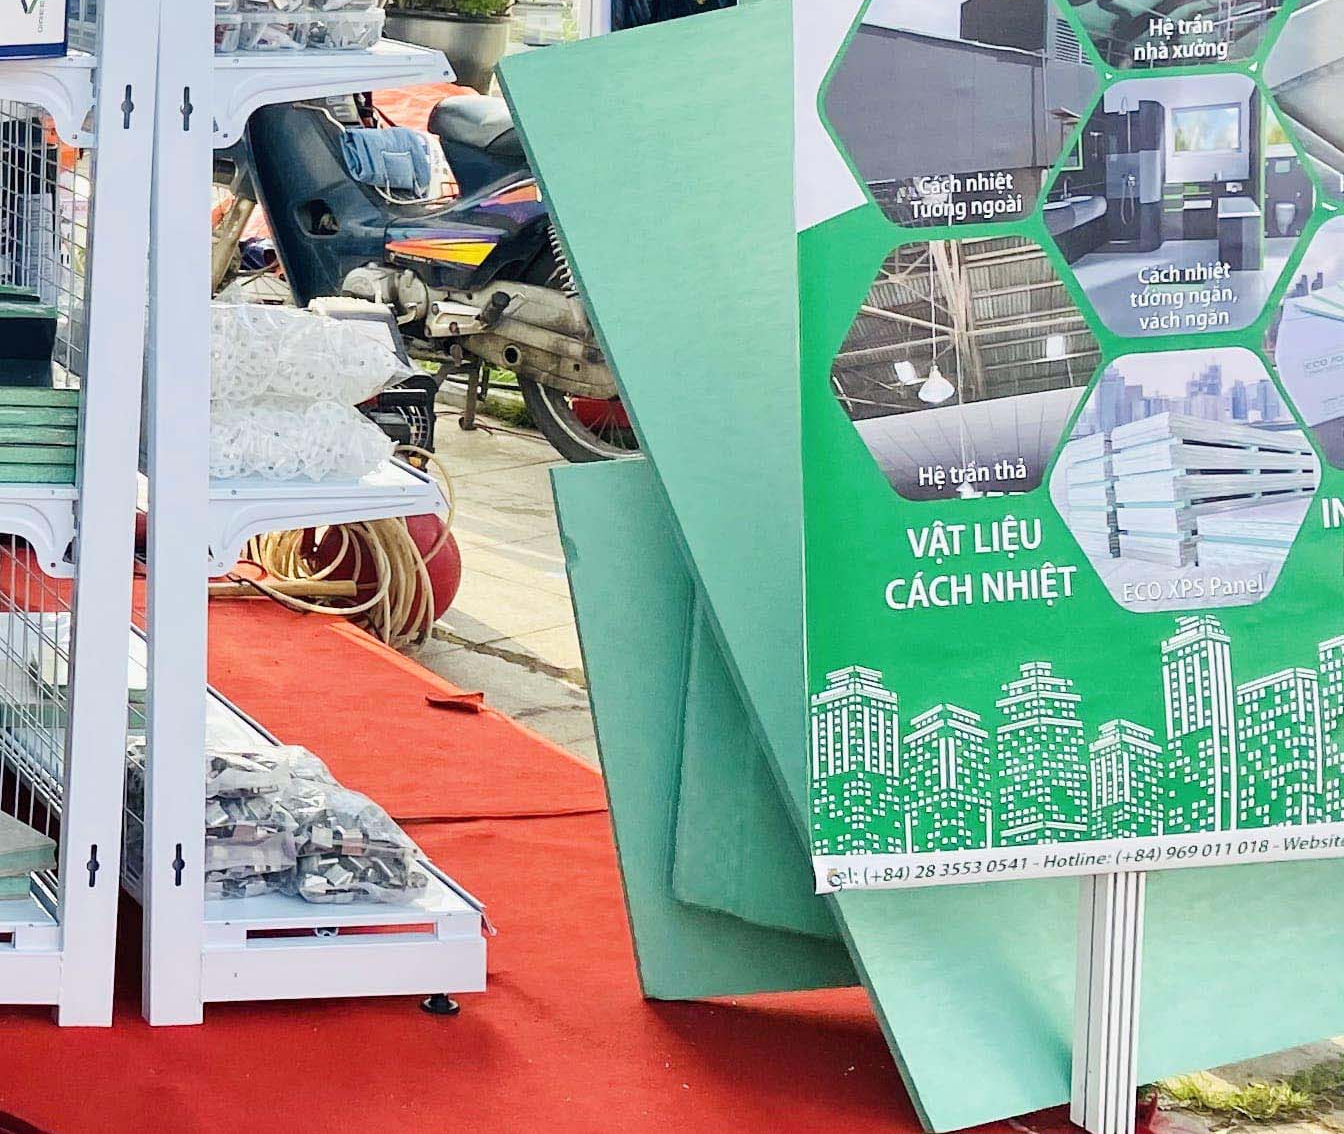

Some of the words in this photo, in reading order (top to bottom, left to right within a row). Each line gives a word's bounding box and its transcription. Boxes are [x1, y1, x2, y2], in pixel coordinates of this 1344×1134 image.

[1149, 18, 1174, 40] Hệ
[1134, 41, 1169, 61] nhà
[919, 176, 962, 194] Cách
[965, 172, 1014, 192] nhiệt
[970, 195, 1023, 219] ngoài
[1138, 264, 1181, 285] Cách
[1185, 261, 1231, 282] nhiệt
[1139, 310, 1181, 331] vách
[918, 464, 946, 487] Hệ
[950, 460, 990, 484] trần
[995, 457, 1027, 480] thả
[907, 520, 965, 565] VẬT
[975, 515, 1043, 560] LIỆU
[884, 569, 973, 610] CÁCH
[982, 565, 1077, 607] NHIỆT
[1123, 580, 1162, 602] ECO
[1167, 577, 1205, 599] XPS
[1210, 572, 1265, 597] Panel
[863, 867, 910, 884] (+84)
[915, 865, 935, 879] 28
[939, 861, 981, 877] 3553
[986, 857, 1027, 873] 0541
[1044, 852, 1112, 868] Hotline:
[1115, 848, 1161, 865] (+84)
[1166, 846, 1198, 860] 969
[1202, 843, 1232, 857] 011
[1238, 840, 1268, 854] 018
